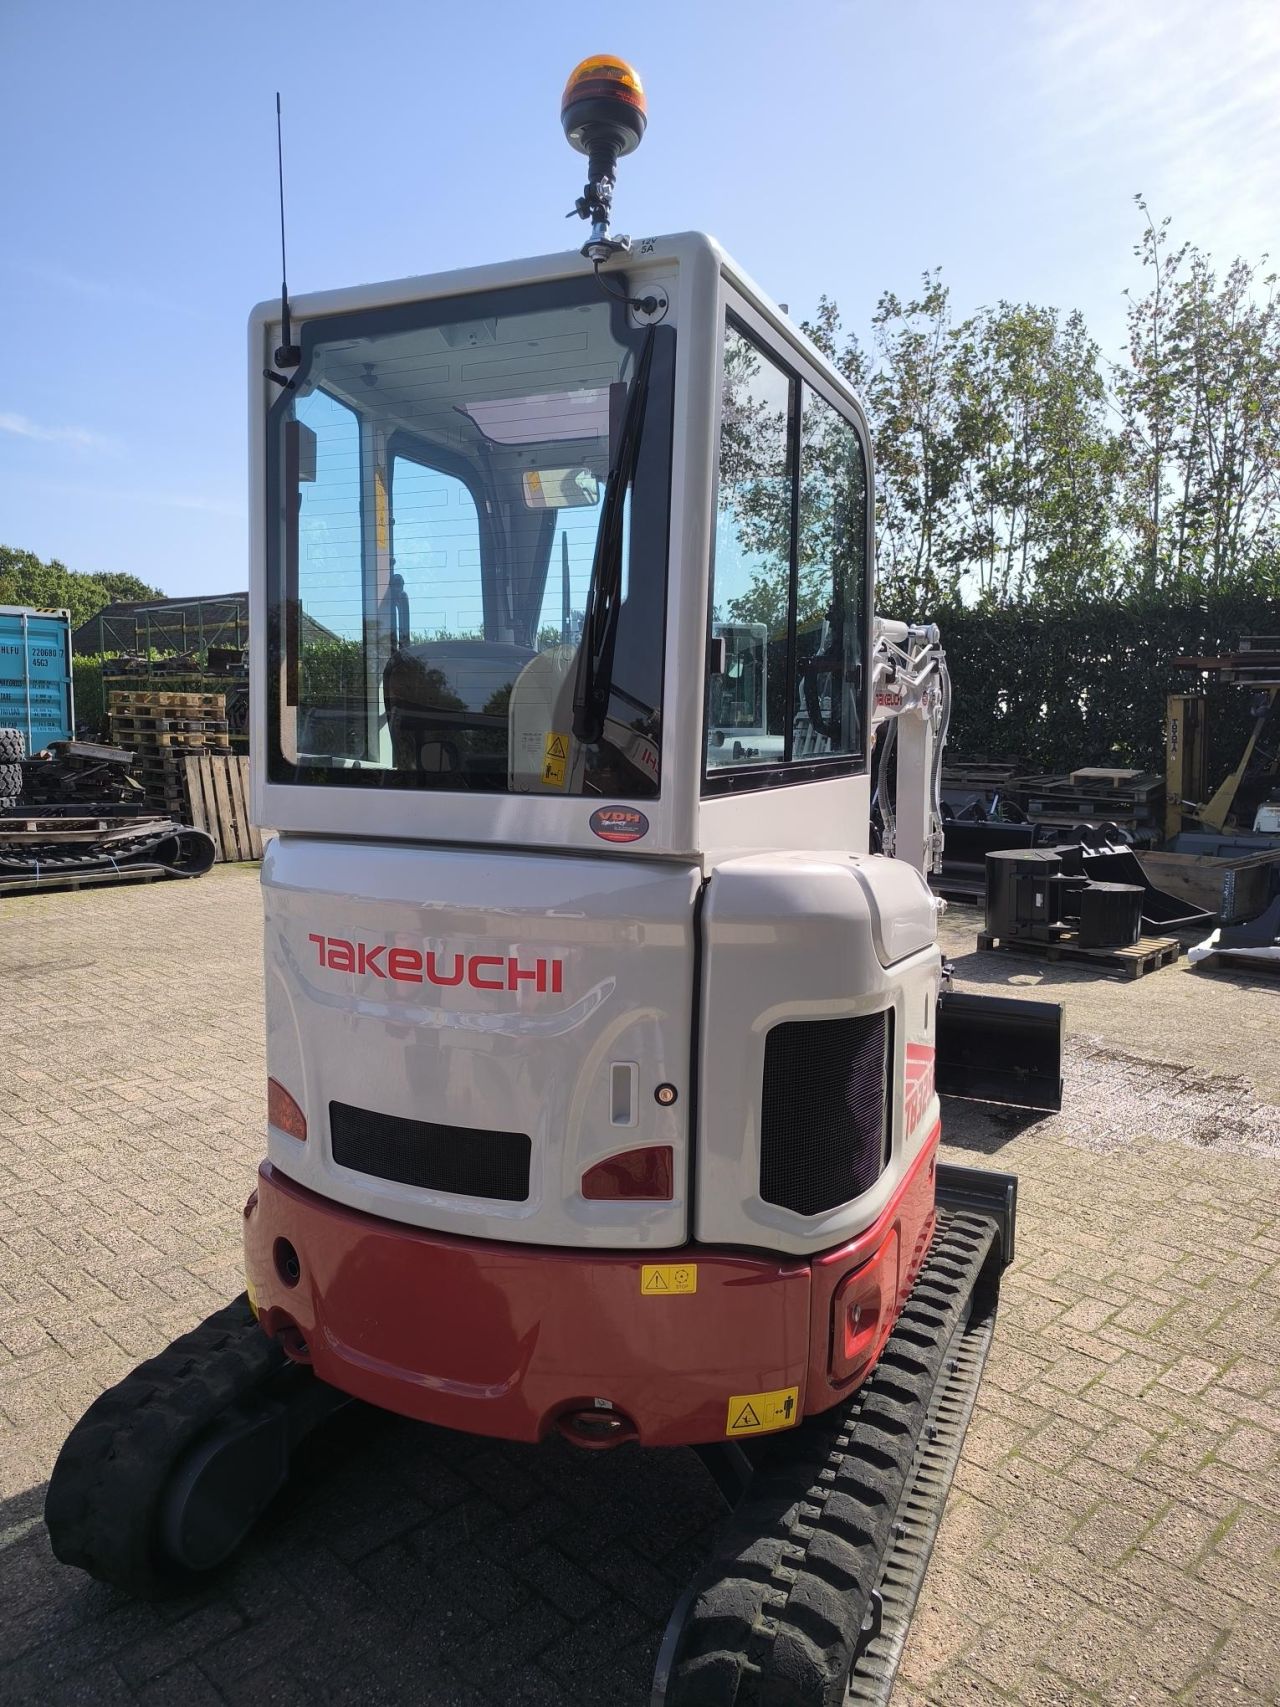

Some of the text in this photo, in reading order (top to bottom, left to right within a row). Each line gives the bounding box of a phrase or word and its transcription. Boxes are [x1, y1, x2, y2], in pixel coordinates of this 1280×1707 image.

[640, 244, 654, 254] 5A
[1, 646, 19, 655] HLFU
[598, 811, 641, 823] VDH
